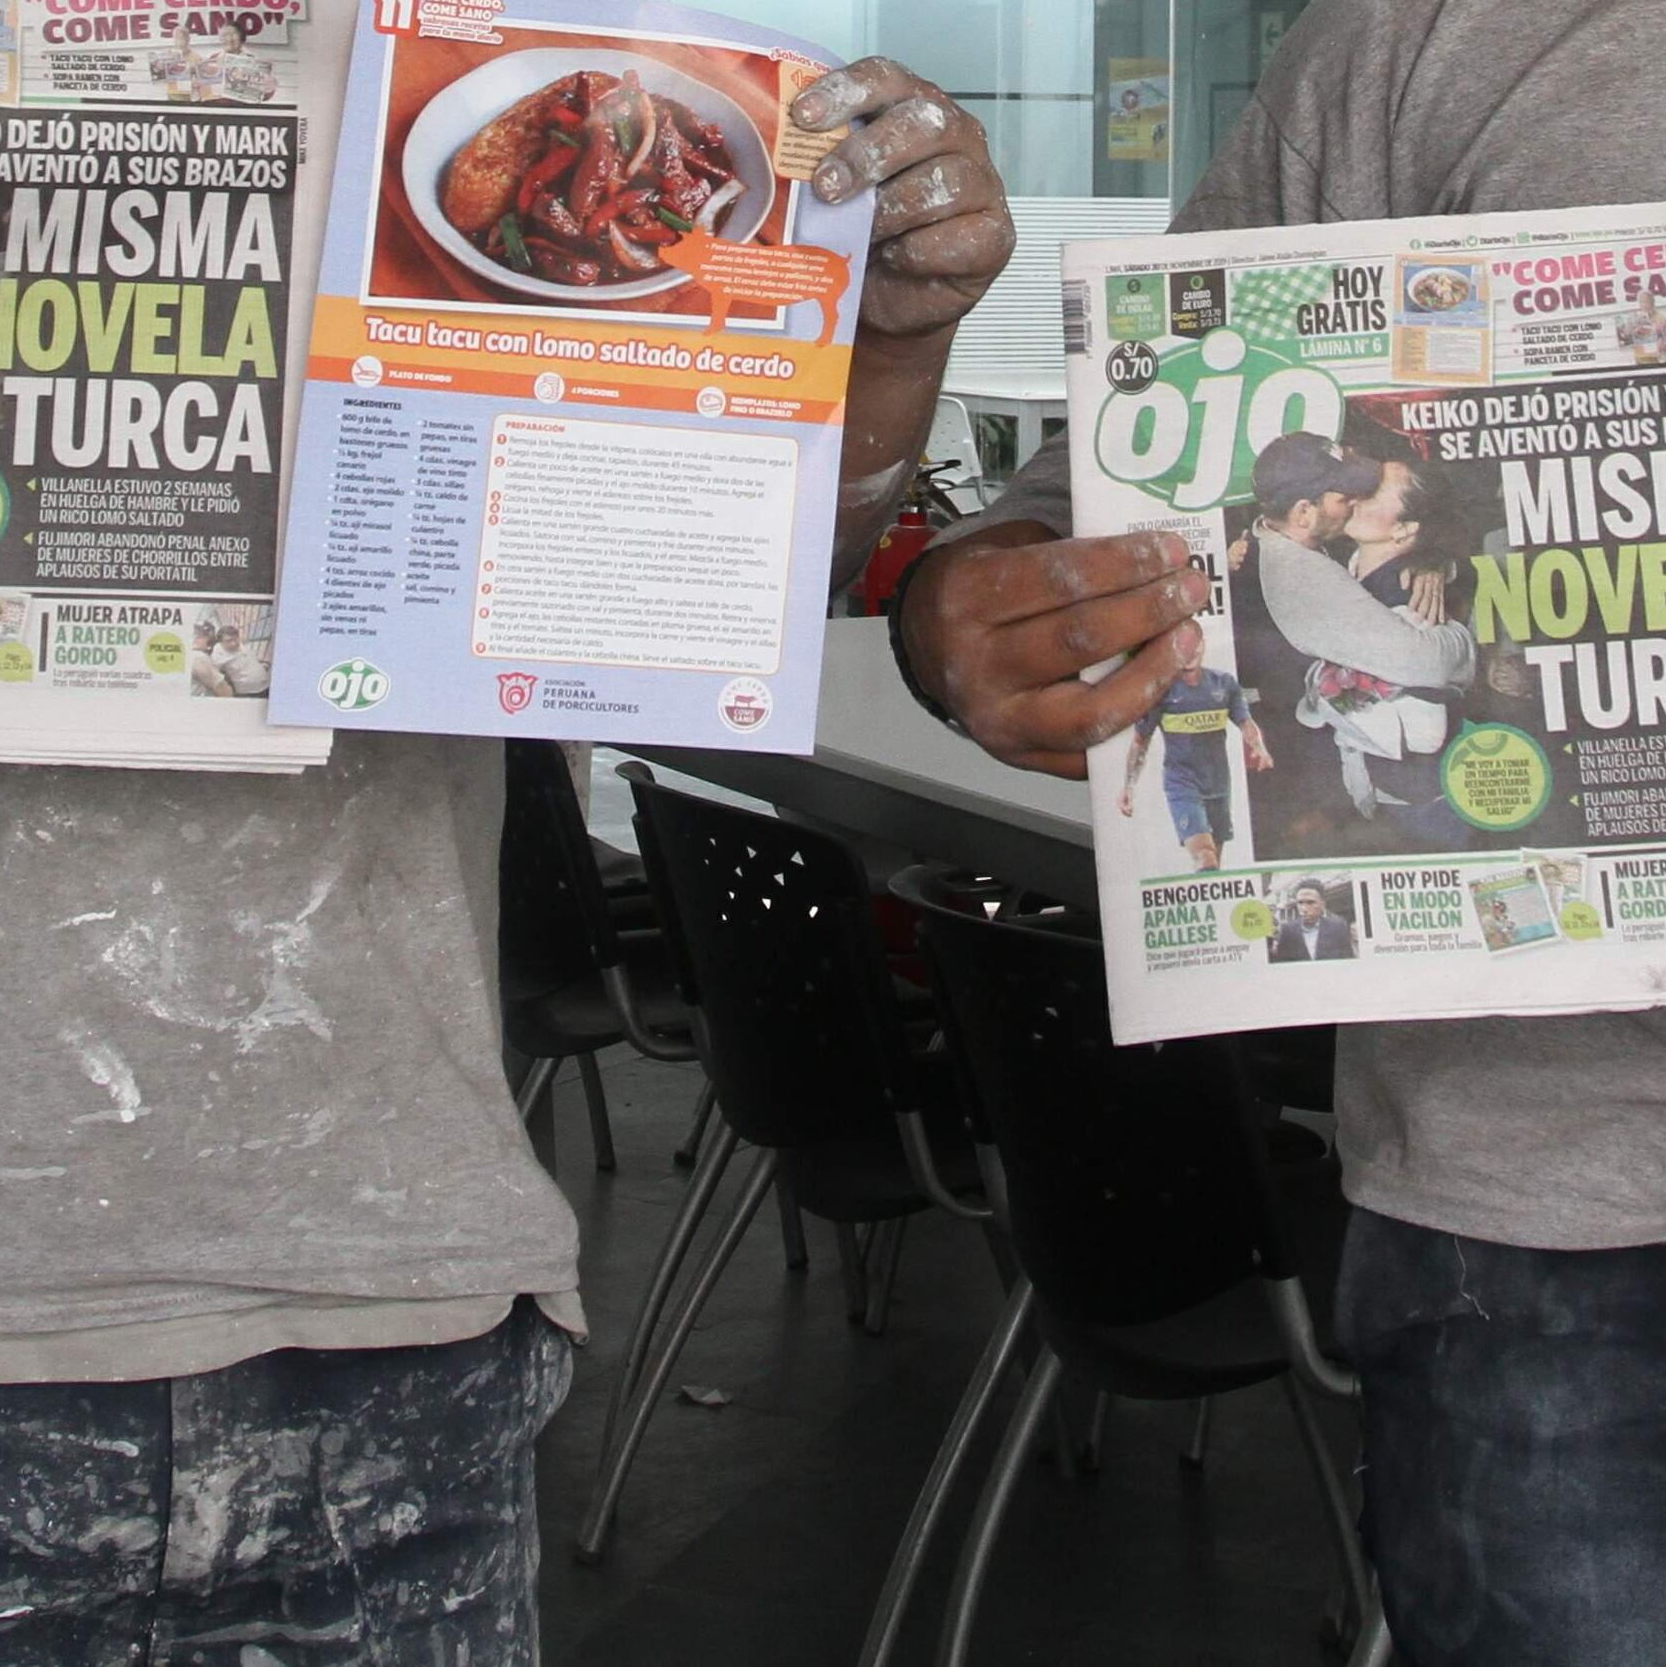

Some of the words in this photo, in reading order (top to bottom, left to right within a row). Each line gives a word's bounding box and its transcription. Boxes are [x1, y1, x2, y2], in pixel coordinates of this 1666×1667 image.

[423, 3, 457, 16] COME
[459, 7, 492, 20] SANO
[43, 14, 153, 44] COME
[7, 112, 75, 150] DEJÓ
[80, 116, 189, 154] PRISIÓN
[193, 124, 210, 152] Y
[215, 126, 288, 155] MARK
[107, 155, 121, 183] A
[127, 157, 180, 185] SUS
[185, 158, 287, 188] BRAZOS
[5, 187, 282, 281] MISMA
[1491, 251, 1616, 286] "COME
[1333, 265, 1384, 299] HOY
[1513, 281, 1615, 316] COME
[1297, 301, 1387, 335] GRATIS
[366, 317, 421, 344] Tacu
[426, 322, 480, 350] tacu
[485, 333, 528, 353] con
[534, 332, 594, 361] lomo
[600, 341, 688, 371] saltado
[695, 346, 724, 373] de
[729, 351, 794, 379] cerdo
[1124, 341, 1139, 358] S/
[1300, 337, 1351, 358] LÁMINA
[1373, 338, 1381, 352] 6
[1111, 351, 1154, 381] 0.70
[1402, 398, 1479, 431] KEIKO
[1483, 389, 1549, 426] DEJÓ
[1555, 381, 1660, 420] PRISIÓN
[3, 377, 272, 473] TURCA
[1098, 330, 1341, 508] ojo
[1439, 432, 1473, 460] SE
[1478, 420, 1578, 458] AVENTÓ
[1583, 421, 1601, 449] A
[1607, 418, 1658, 448] SUS
[41, 478, 112, 494] VILLANELLA
[114, 480, 162, 494] ESTUVO
[164, 481, 171, 494] 2
[173, 481, 232, 497] SEMANAS
[40, 494, 57, 508] EN
[59, 495, 107, 509] HUELGA
[110, 496, 125, 509] DE
[128, 497, 177, 511] HAMBRE
[180, 498, 189, 511] Y
[191, 498, 205, 512] LE
[39, 509, 57, 523] UN
[59, 510, 88, 524] RICO
[91, 511, 126, 526] LOMO
[129, 512, 184, 527] SALTADO
[38, 532, 94, 547] FUJIMORI
[168, 536, 207, 550] PENAL
[210, 537, 250, 552] ANEXO
[37, 547, 53, 561] DE
[55, 547, 112, 563] MUJERES
[115, 549, 130, 563] DE
[132, 549, 207, 566] CHORRILLOS
[210, 553, 248, 568] ENTRE
[36, 562, 101, 578] APLAUSOS
[103, 564, 118, 578] DE
[121, 565, 138, 580] SU
[57, 605, 112, 623] MUJER
[118, 606, 183, 625] ATRAPA
[55, 626, 67, 643] A
[72, 627, 140, 645] RATERO
[55, 648, 117, 666] GORDO
[323, 660, 387, 706] ojo
[543, 688, 596, 699] PERUANA
[542, 699, 556, 710] DE
[559, 700, 639, 714] PORCICULTORES
[1380, 871, 1417, 889] HOY
[1422, 870, 1461, 887] PIDE
[1142, 880, 1255, 909] BENGOECHEA
[1383, 892, 1406, 910] EN
[1410, 890, 1462, 909] MODO
[1617, 882, 1630, 900] A
[1204, 904, 1215, 922] A
[1145, 924, 1218, 949] GALLESE
